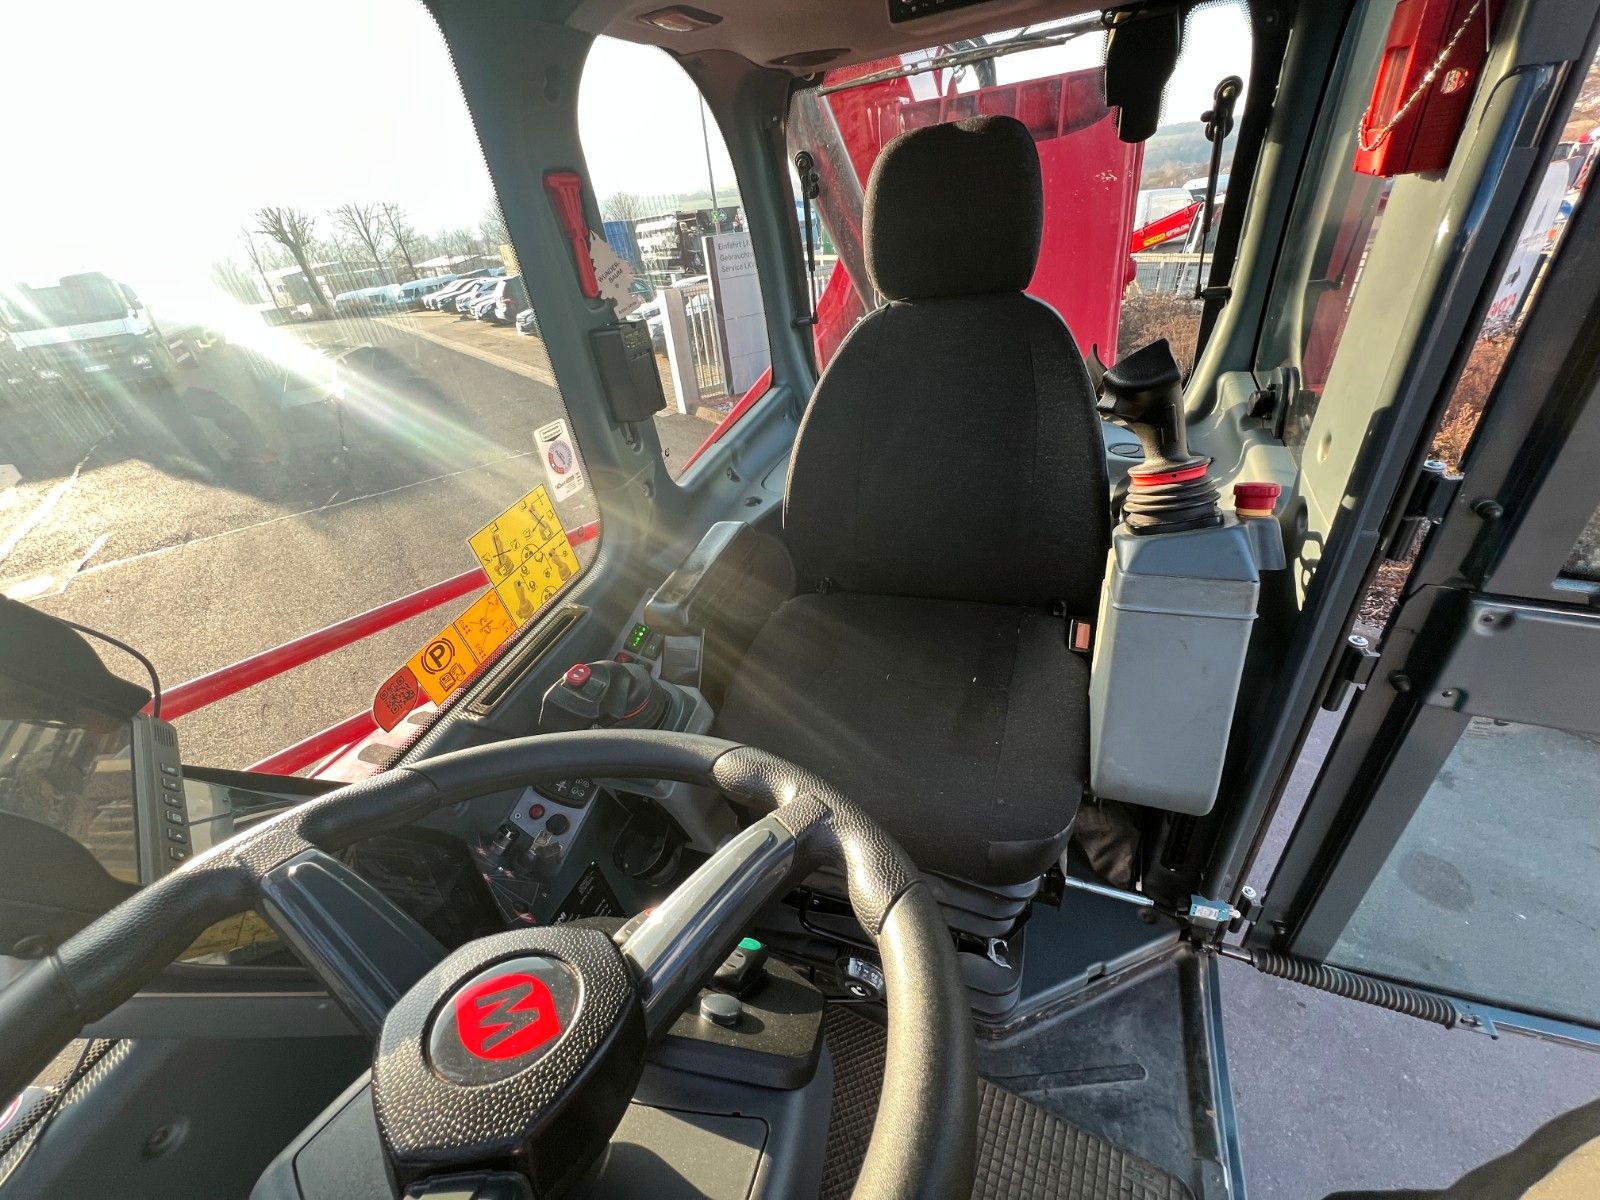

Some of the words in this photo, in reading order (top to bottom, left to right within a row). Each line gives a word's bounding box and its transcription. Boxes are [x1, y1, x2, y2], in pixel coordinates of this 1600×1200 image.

[718, 240, 741, 250] Einfahrt
[721, 264, 743, 273] Service
[608, 268, 623, 284] BAUM
[428, 644, 445, 668] P
